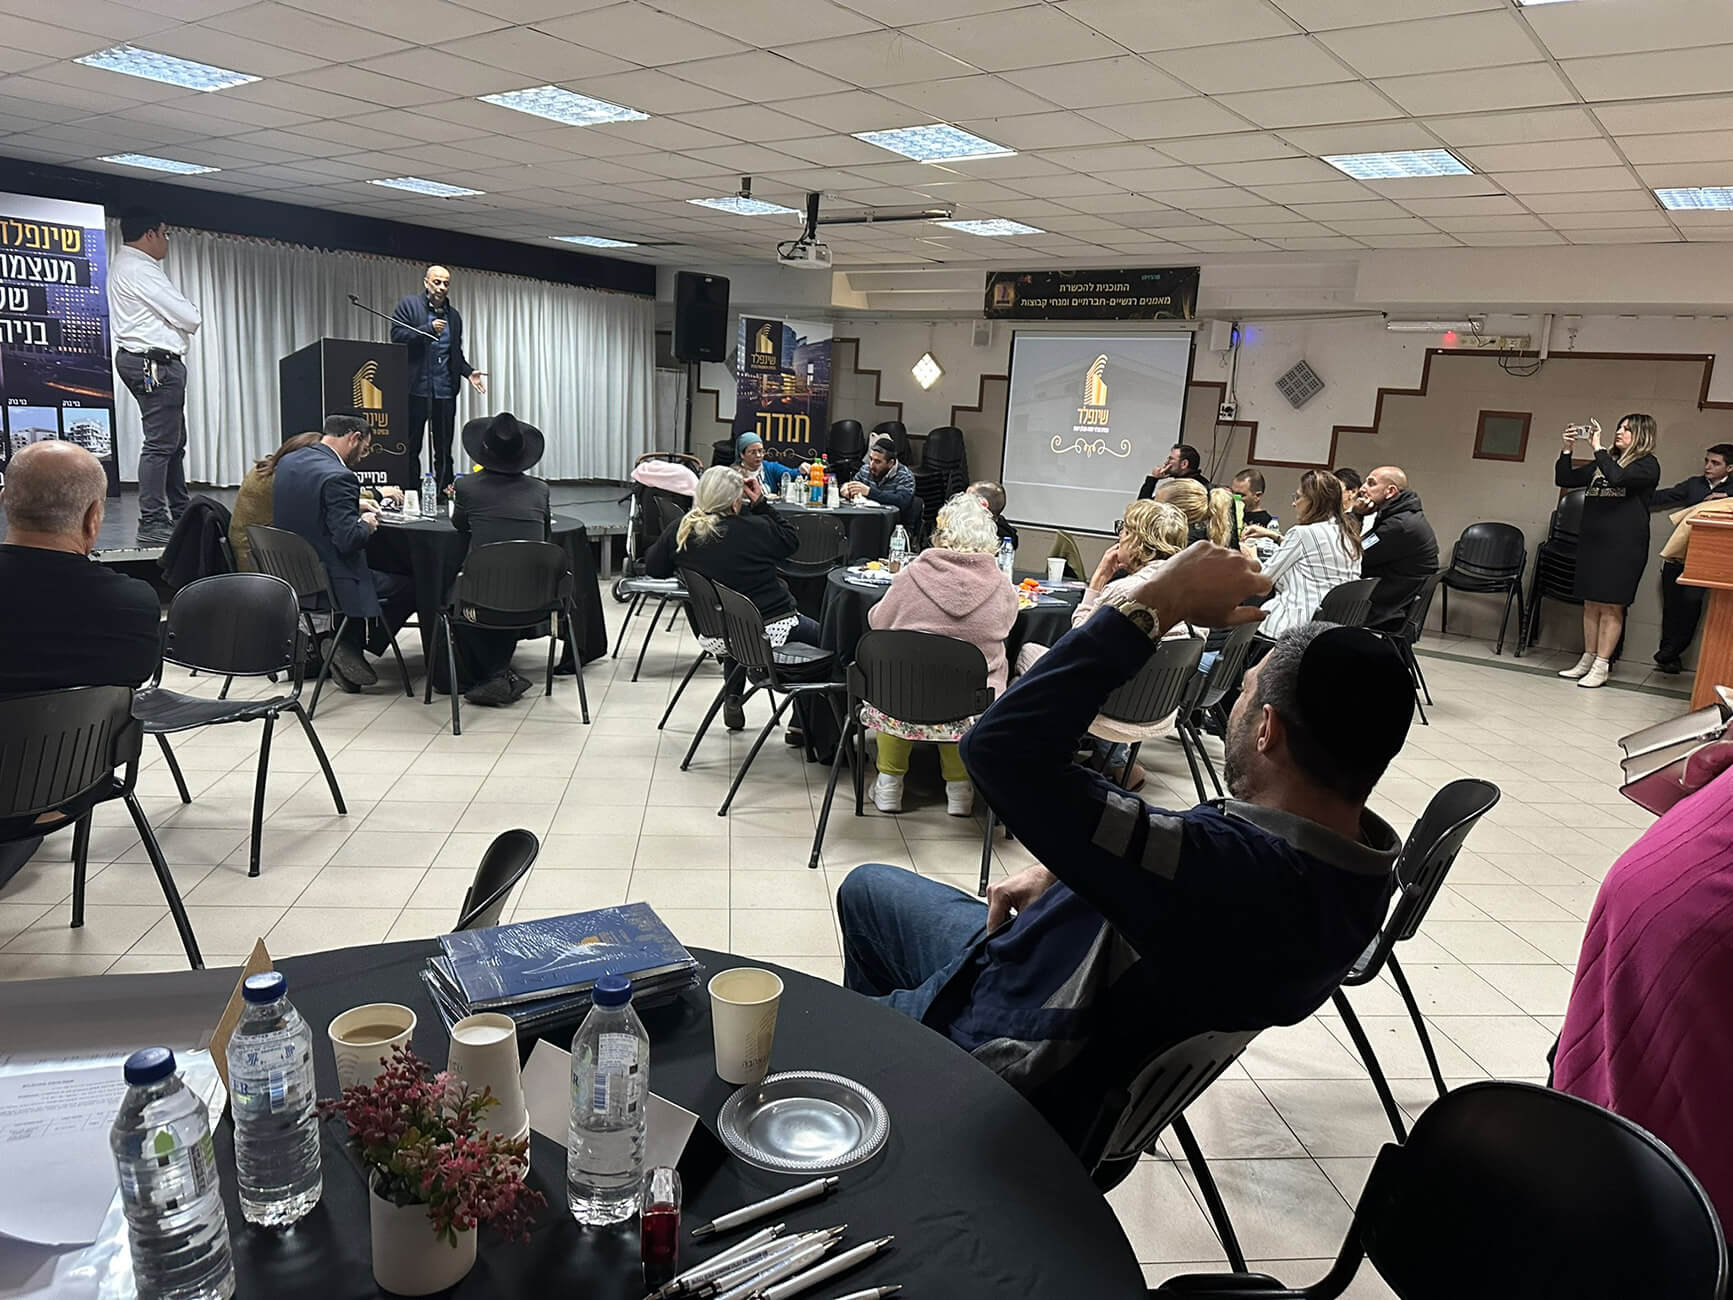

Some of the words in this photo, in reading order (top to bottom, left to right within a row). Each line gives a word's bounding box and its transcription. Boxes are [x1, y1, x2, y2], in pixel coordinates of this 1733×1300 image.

[1059, 282, 1094, 293] להכשרת
[1095, 283, 1130, 292] התוכנית
[1020, 298, 1048, 309] קבוצות
[1049, 298, 1069, 307] ומנחי
[1139, 296, 1171, 305] מאמנים
[0, 319, 49, 345] בניה
[751, 352, 777, 365] שינפלד
[1077, 406, 1110, 426] שינפלד
[756, 412, 810, 443] תודה
